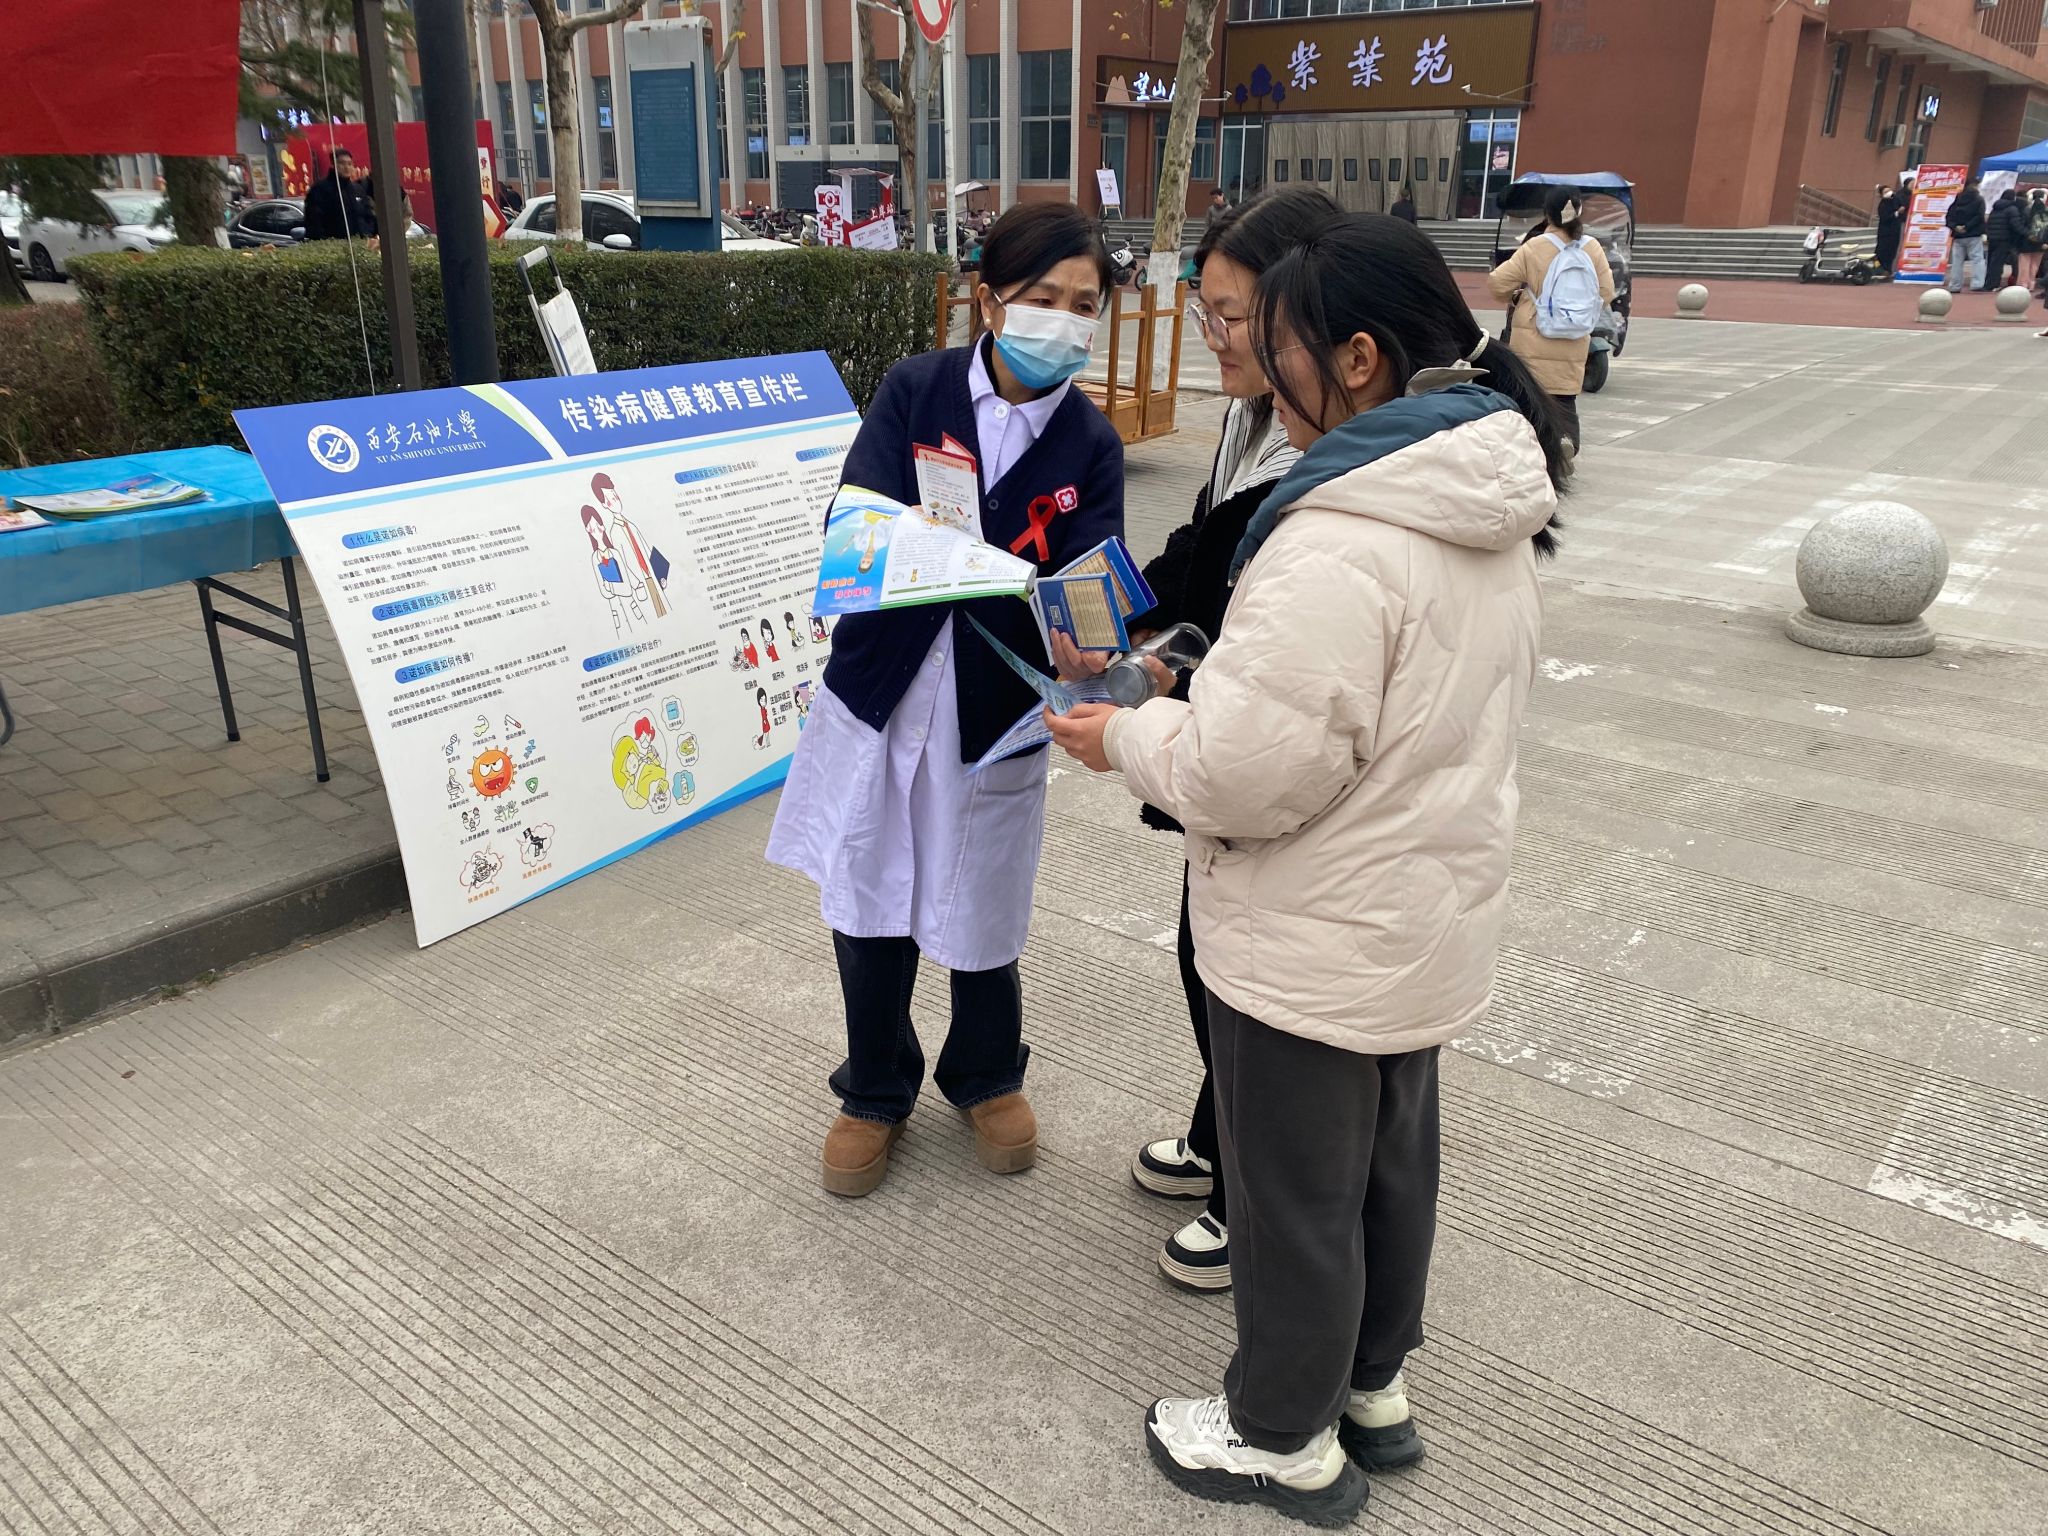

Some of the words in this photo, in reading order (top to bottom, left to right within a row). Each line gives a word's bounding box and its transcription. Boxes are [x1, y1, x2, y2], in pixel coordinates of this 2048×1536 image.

[559, 372, 809, 433] 传染病健康教育宣传栏
[375, 453, 403, 465] XI'AN
[403, 446, 437, 460] SHIYOU
[437, 440, 487, 456] UNIVERSITY
